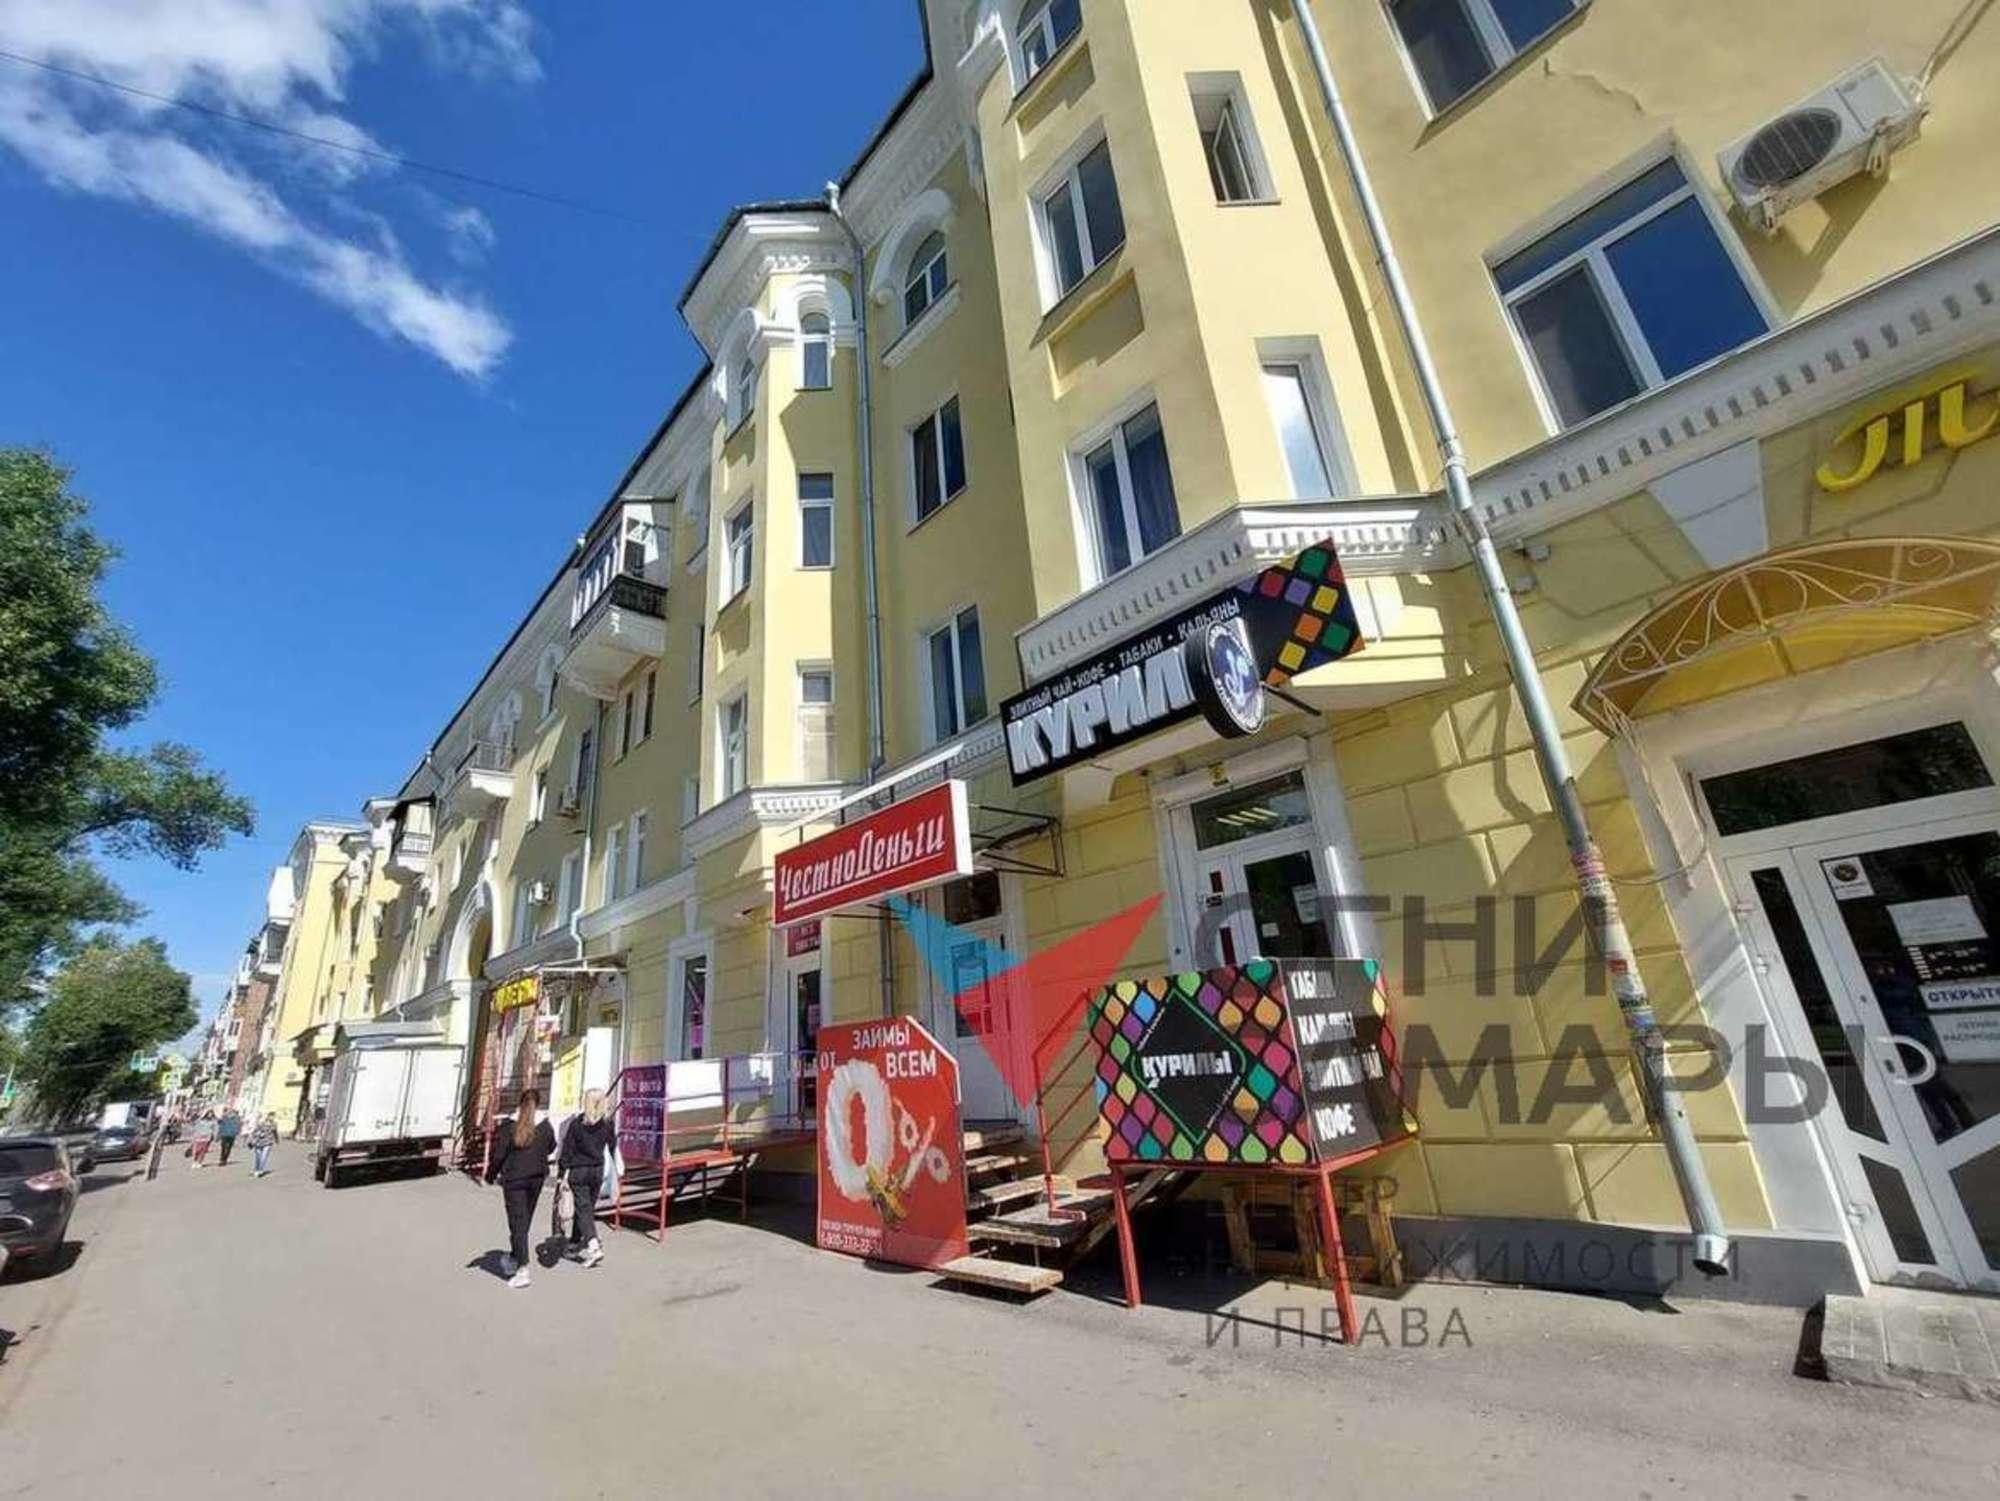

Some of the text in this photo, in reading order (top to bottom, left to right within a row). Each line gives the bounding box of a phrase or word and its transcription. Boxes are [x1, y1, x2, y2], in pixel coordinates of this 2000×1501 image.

[1118, 634, 1164, 668] ТАБАКИ
[886, 1049, 937, 1079] ВСЕМ
[1141, 1050, 1233, 1081] КУРИЛЫ
[1314, 1103, 1357, 1141] КОФЕ
